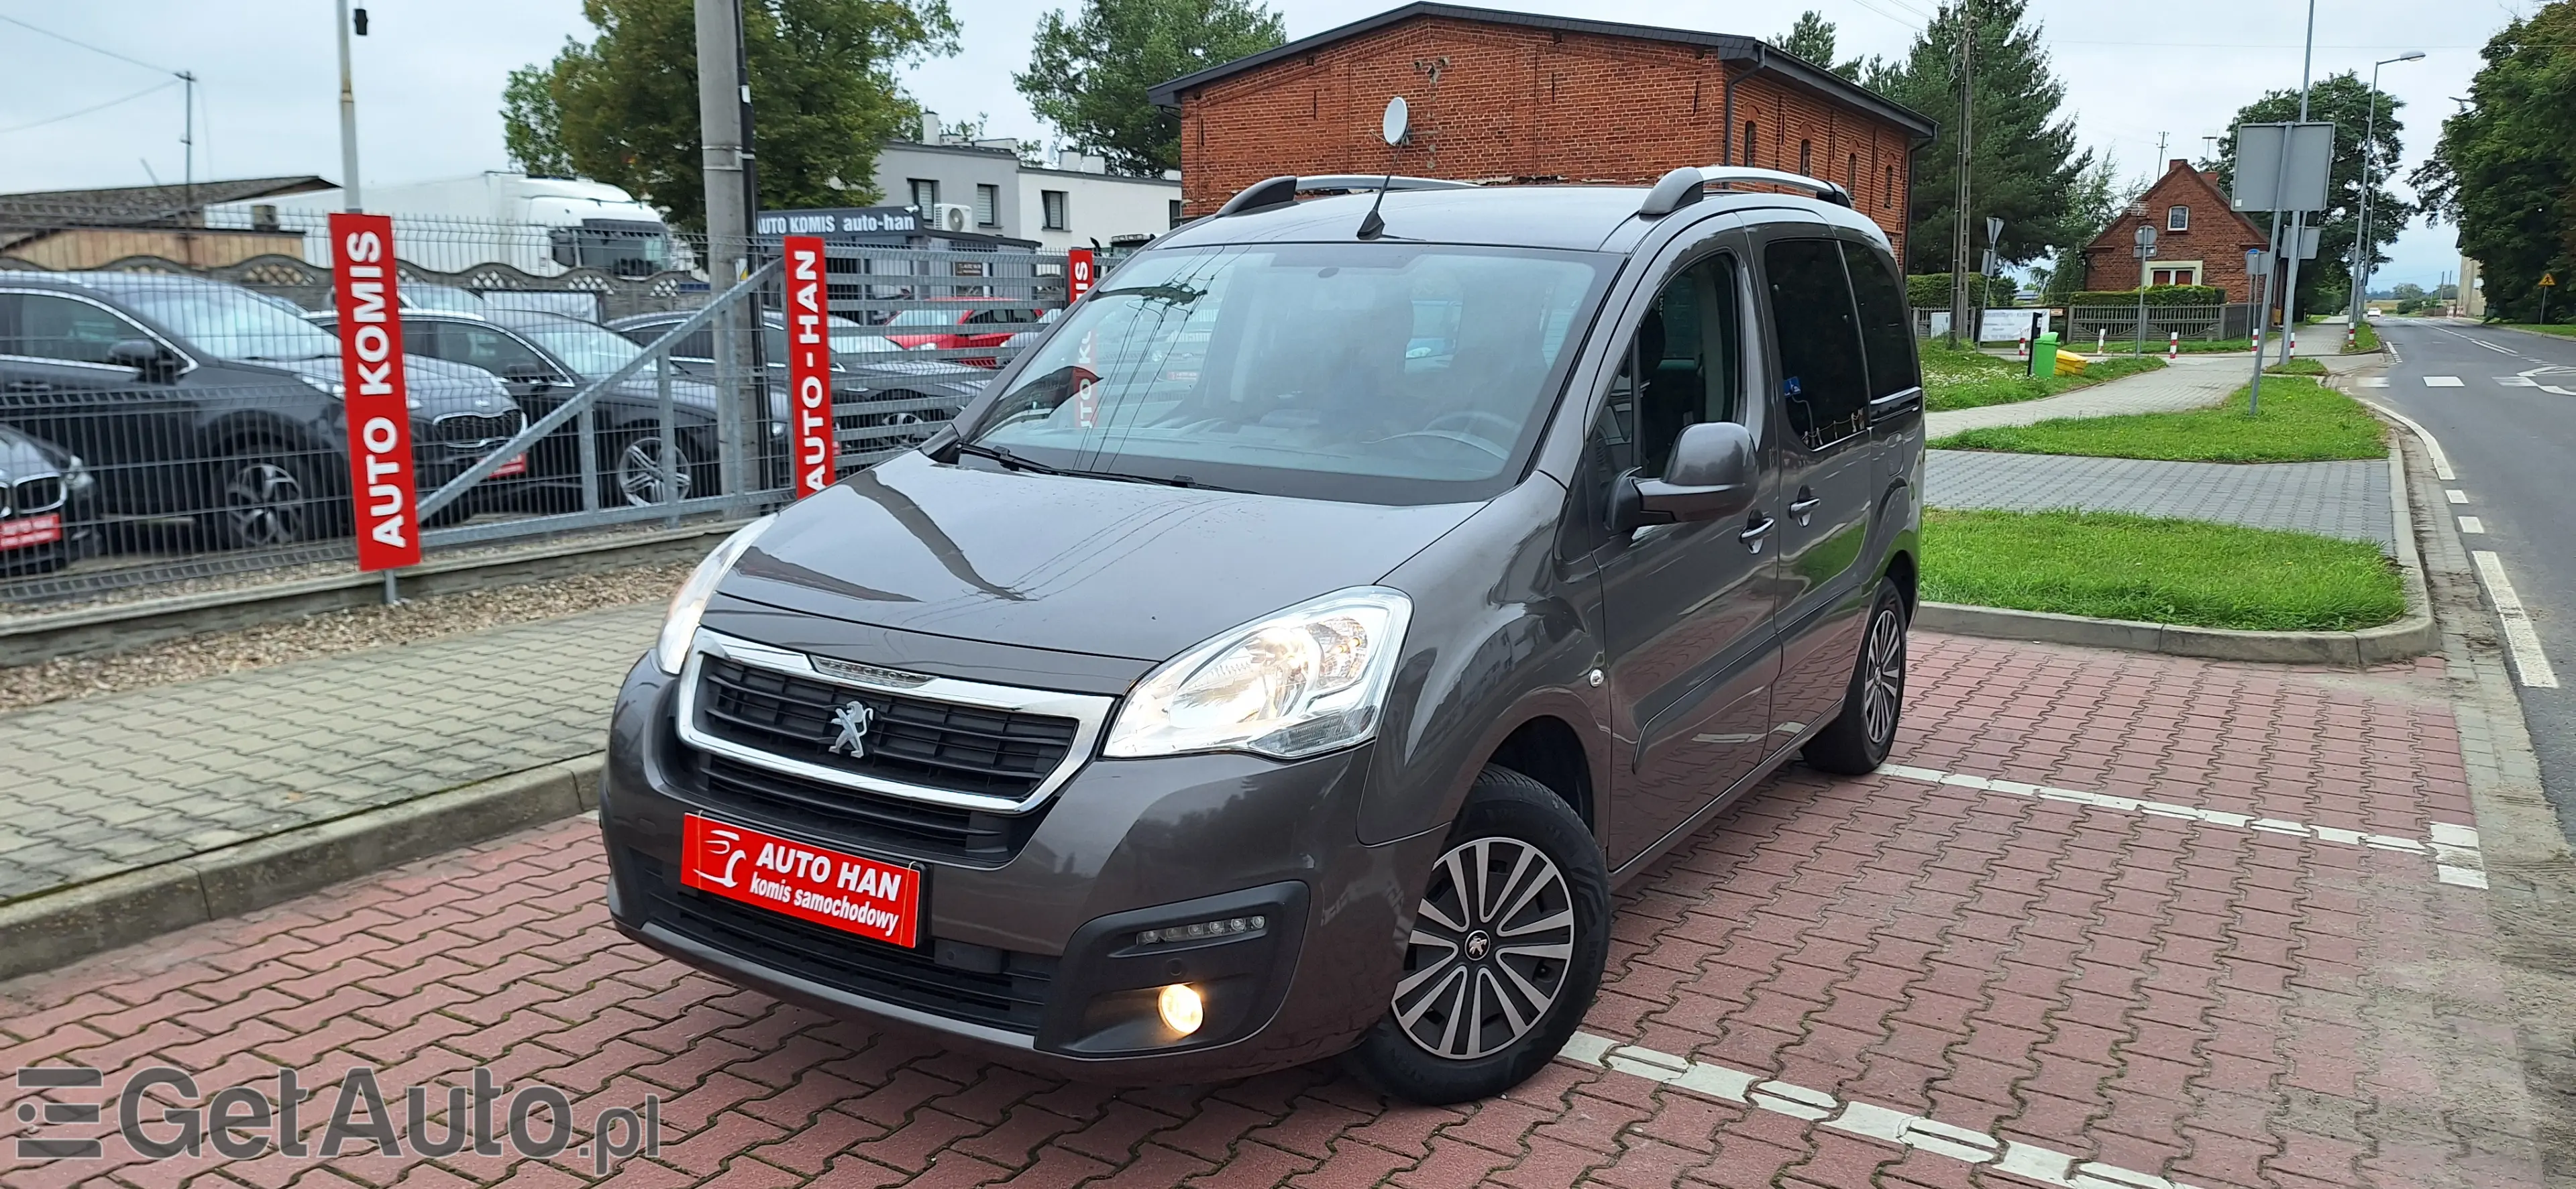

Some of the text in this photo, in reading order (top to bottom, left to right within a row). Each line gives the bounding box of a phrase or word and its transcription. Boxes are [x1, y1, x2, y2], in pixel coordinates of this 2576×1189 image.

[790, 215, 835, 233] KOMIS
[843, 213, 915, 231] auto-han
[346, 231, 406, 548] AUTO KOMIS
[755, 842, 902, 901] AUTO HAN
[749, 871, 899, 937] komis samochodowy
